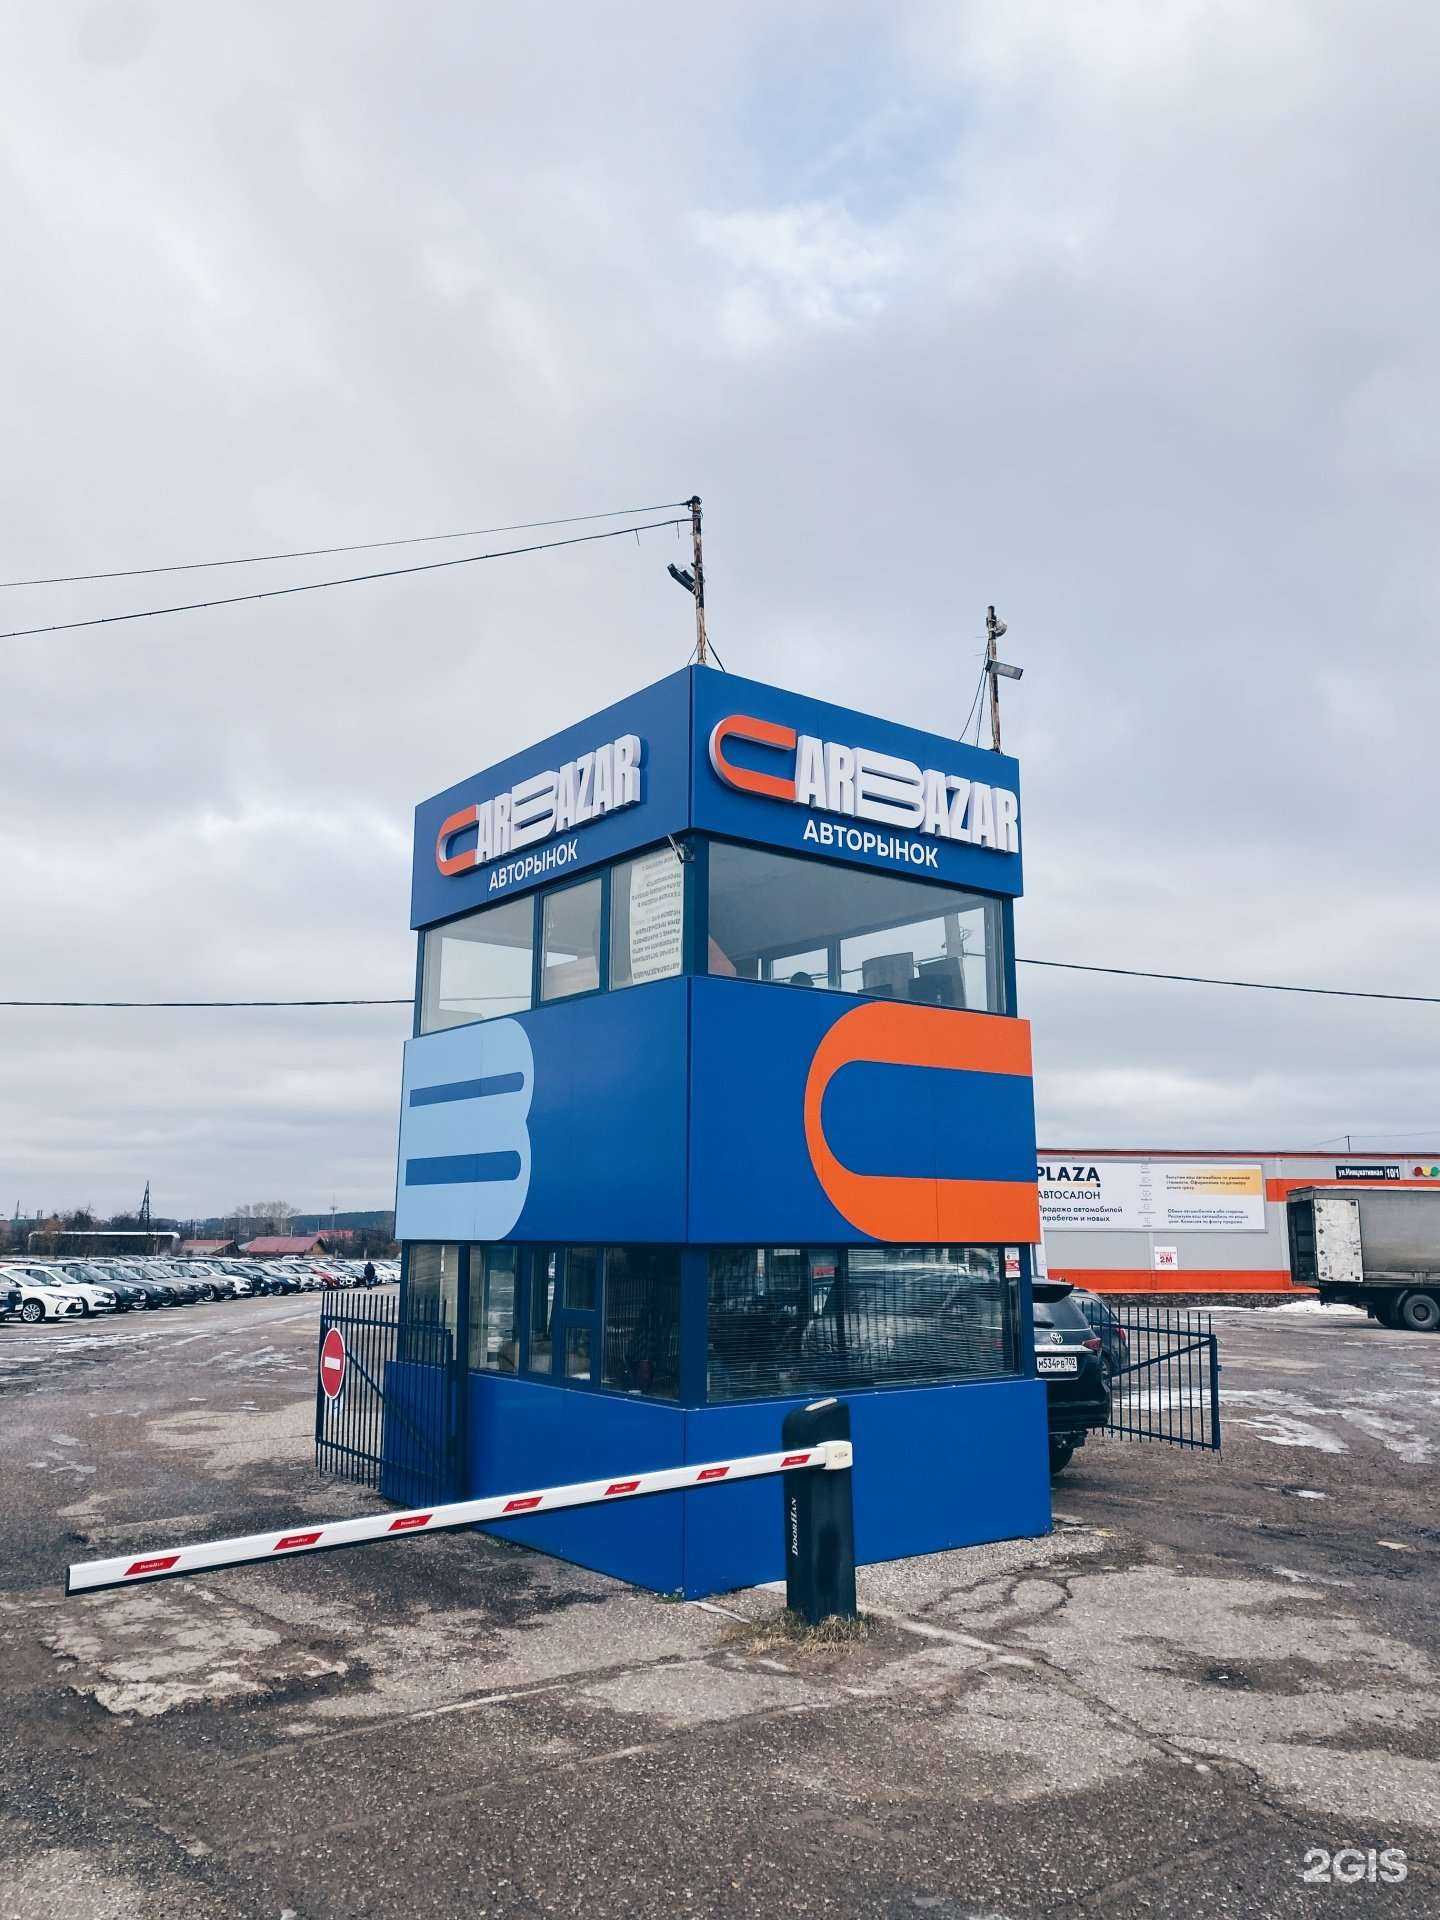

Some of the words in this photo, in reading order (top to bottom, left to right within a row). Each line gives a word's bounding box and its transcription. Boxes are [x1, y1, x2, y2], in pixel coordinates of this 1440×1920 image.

[435, 734, 641, 876] CARBAZAR
[709, 714, 1018, 853] CARBAZAR
[489, 839, 578, 891] АВТОРЫНОК
[803, 819, 939, 868] АВТОРЫНОК
[1037, 1166, 1101, 1182] PLAZA
[1038, 1190, 1101, 1200] АВТОСАЛОН
[1042, 1214, 1078, 1222] пробегом
